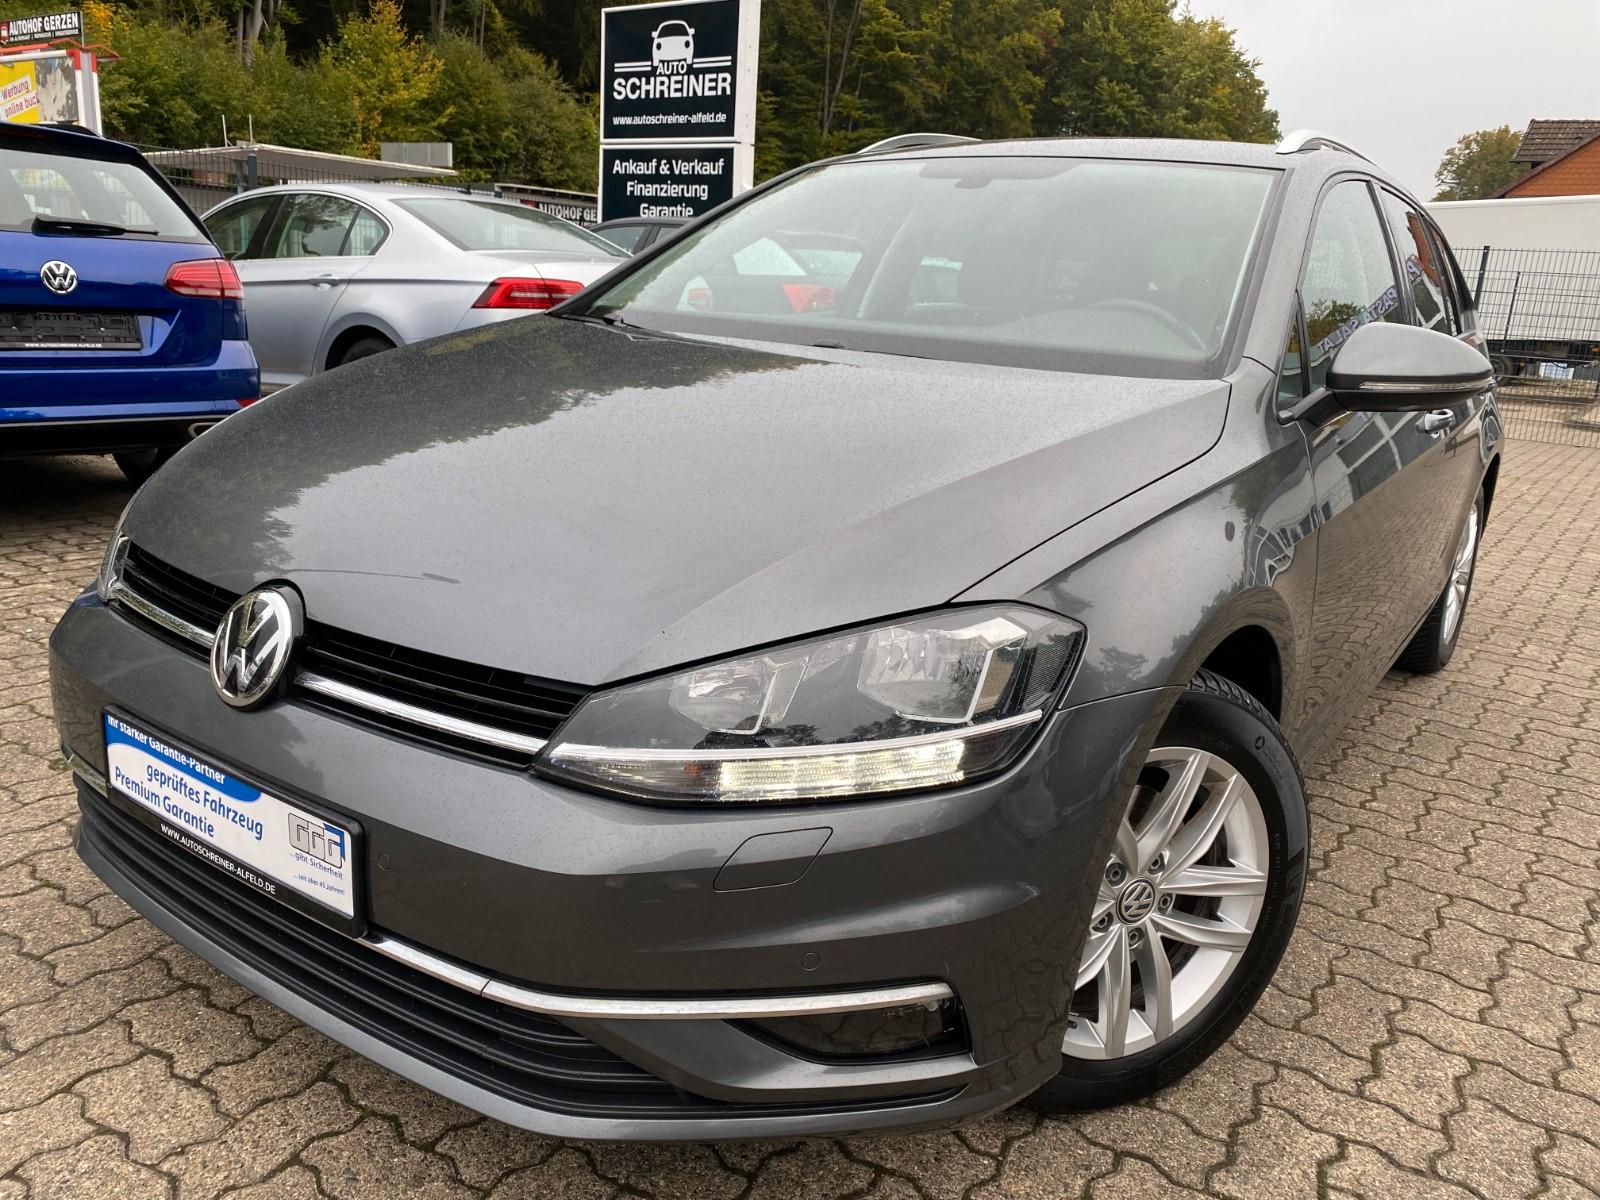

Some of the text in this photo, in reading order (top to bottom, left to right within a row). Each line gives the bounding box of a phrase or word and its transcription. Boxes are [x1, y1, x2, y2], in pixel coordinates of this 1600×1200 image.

[9, 17, 42, 36] AUTOHOF
[43, 12, 79, 31] GERZEN
[656, 61, 688, 75] AUTO
[1, 80, 29, 100] Werbung
[612, 72, 732, 100] SCHREINER
[612, 111, 727, 126] www.autoschreiner-alfeld.de
[612, 158, 725, 175] Ankauf & Verkauf
[626, 180, 709, 200] Finanzierung
[538, 203, 583, 220] AUTOHOF
[640, 203, 694, 218] Garantie
[119, 721, 148, 745] starker
[148, 736, 226, 785] Garantie-Partner
[114, 766, 215, 838] Premium Garantie
[146, 764, 263, 841] geprüftes Fahrzeug
[160, 822, 276, 895] WWW.AUTOSCHREINER-ALFELD.DE
[309, 857, 344, 880] Sicherheit
